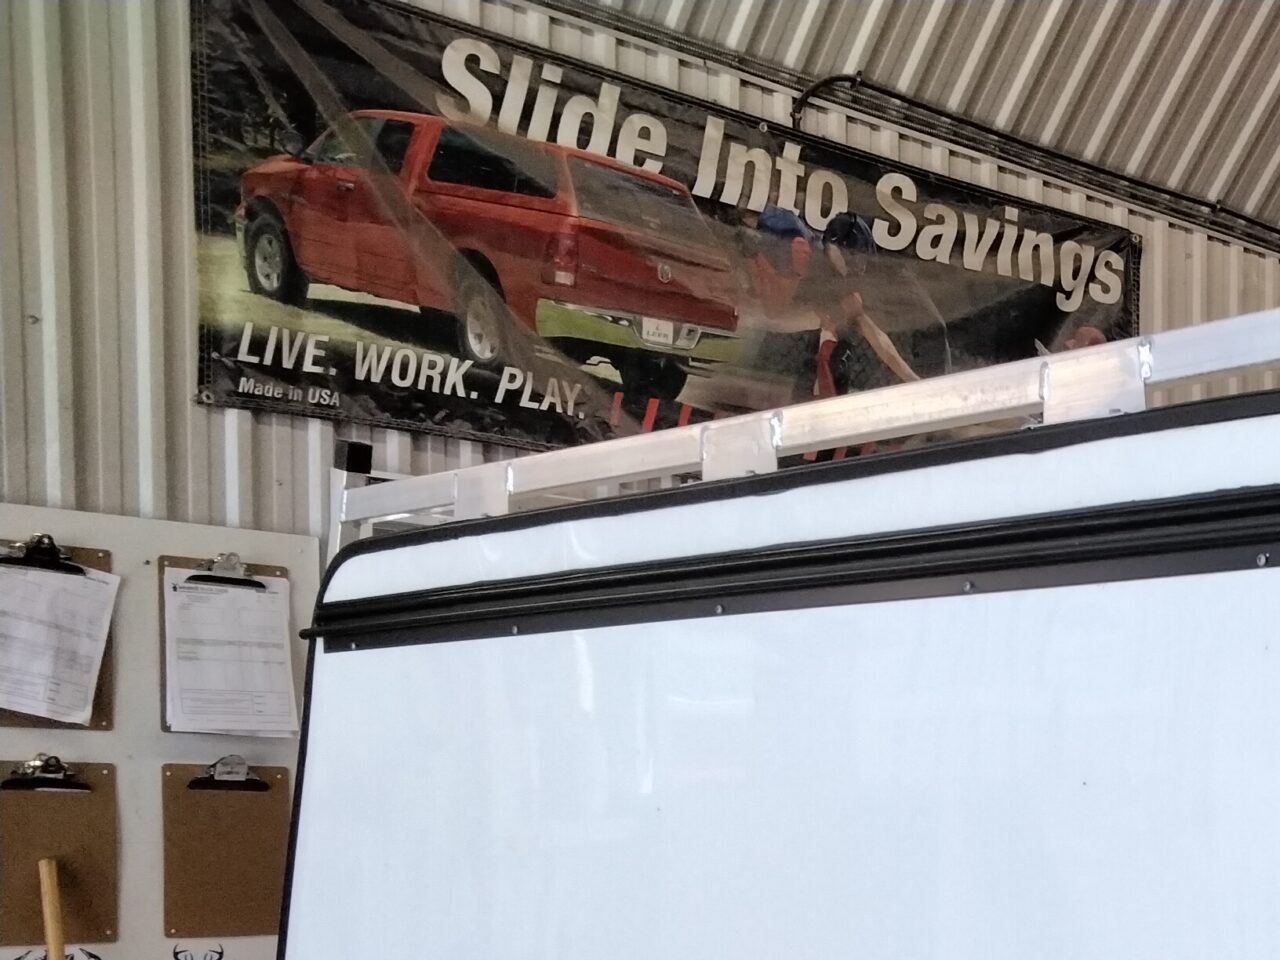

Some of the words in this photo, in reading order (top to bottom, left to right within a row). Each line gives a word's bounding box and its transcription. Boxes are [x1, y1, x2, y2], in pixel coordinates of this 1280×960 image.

[435, 37, 669, 174] Slide
[692, 115, 849, 232] Into
[871, 172, 1125, 312] Savings
[236, 321, 338, 377] LIVE.
[354, 340, 479, 400] WORK.
[494, 366, 586, 420] PLAY.
[238, 377, 283, 399] Made
[288, 384, 303, 402] in
[307, 387, 340, 407] USA
